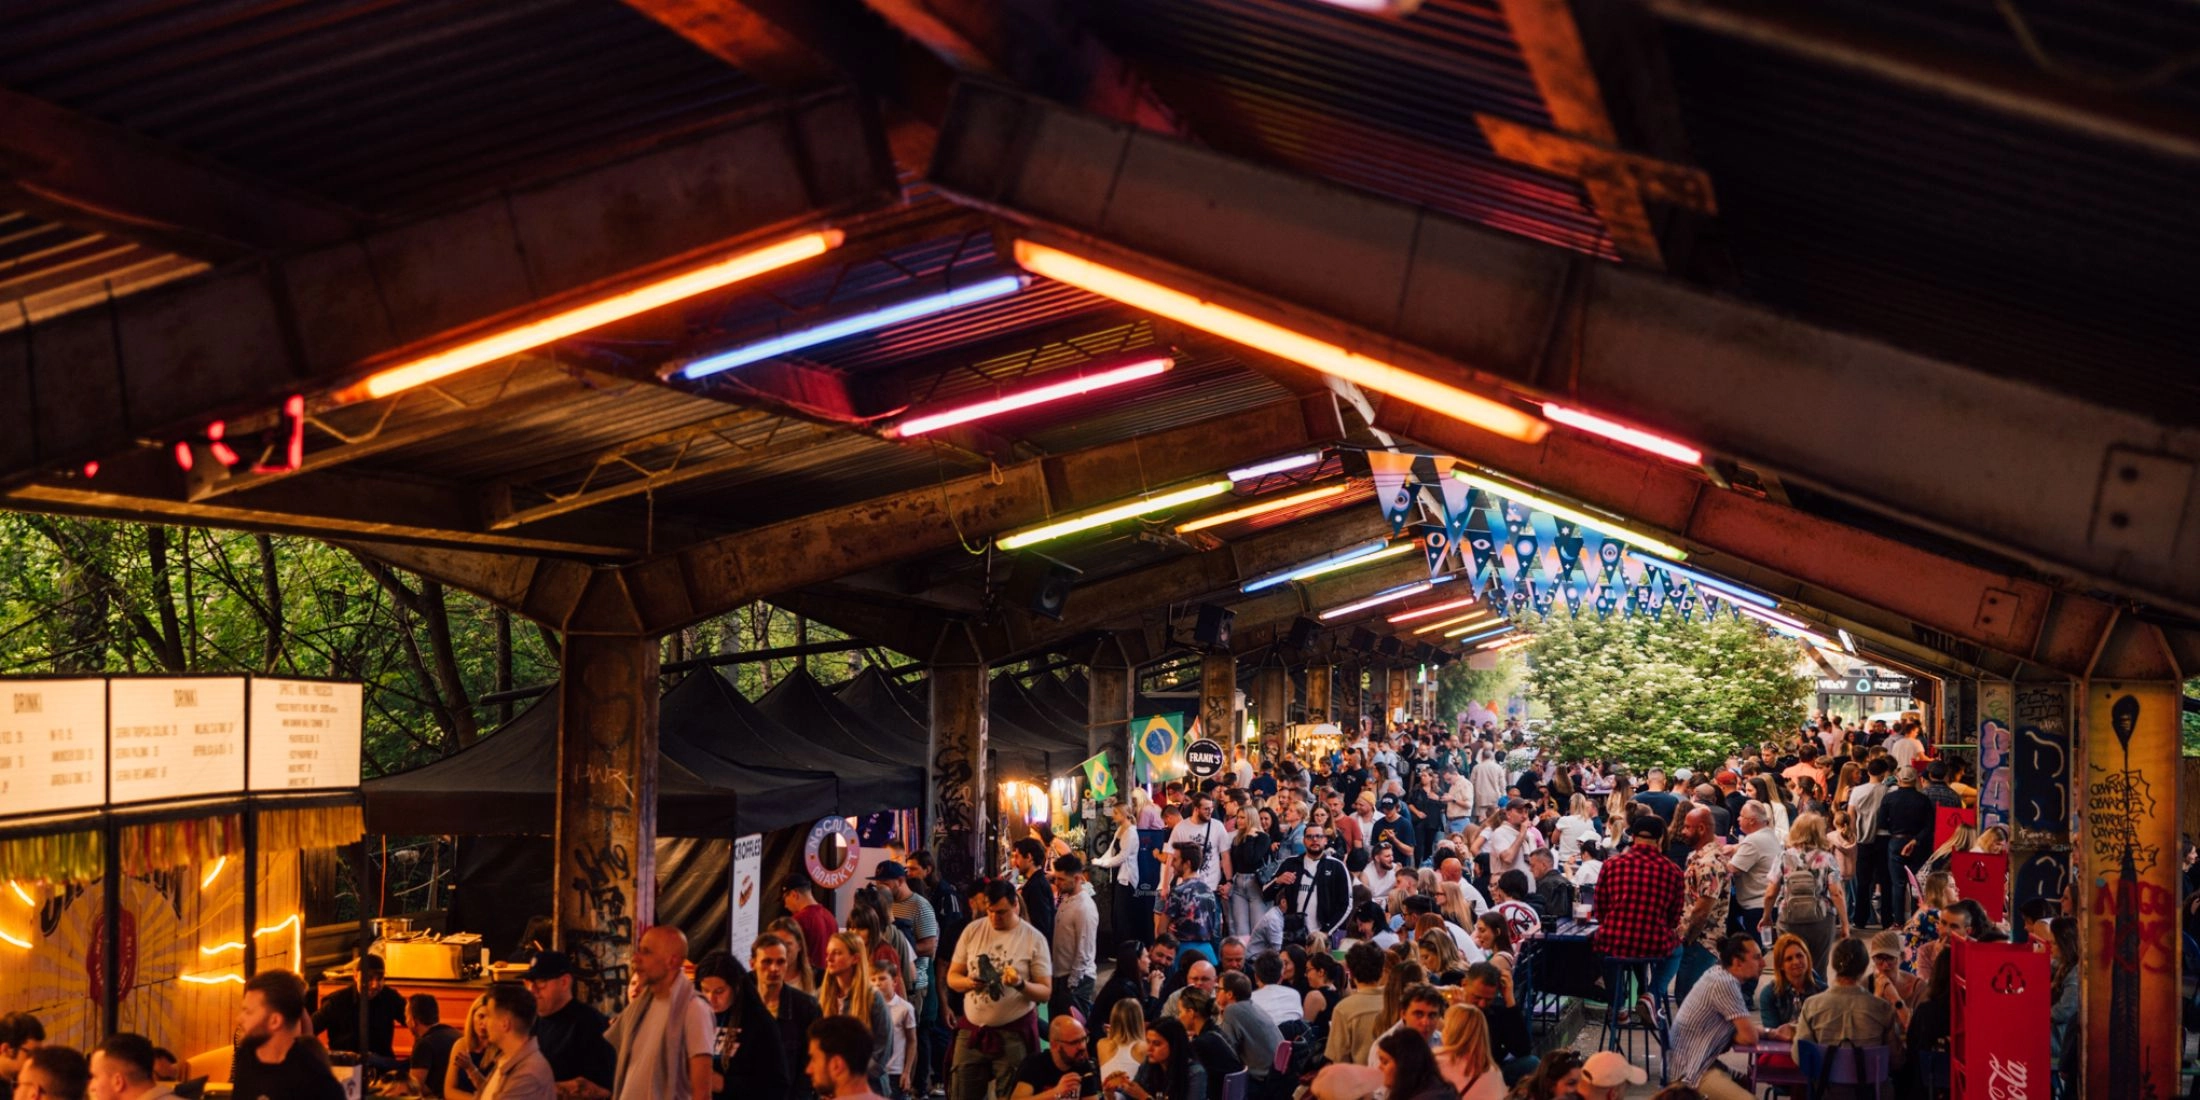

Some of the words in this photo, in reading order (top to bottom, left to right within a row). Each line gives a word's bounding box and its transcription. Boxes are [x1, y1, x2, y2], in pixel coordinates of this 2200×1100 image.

[14, 693, 42, 713] DRINK
[174, 689, 198, 707] DRINK
[1189, 752, 1221, 765] FRANK'S
[809, 818, 852, 849] NOCNY
[812, 851, 857, 885] MARKET
